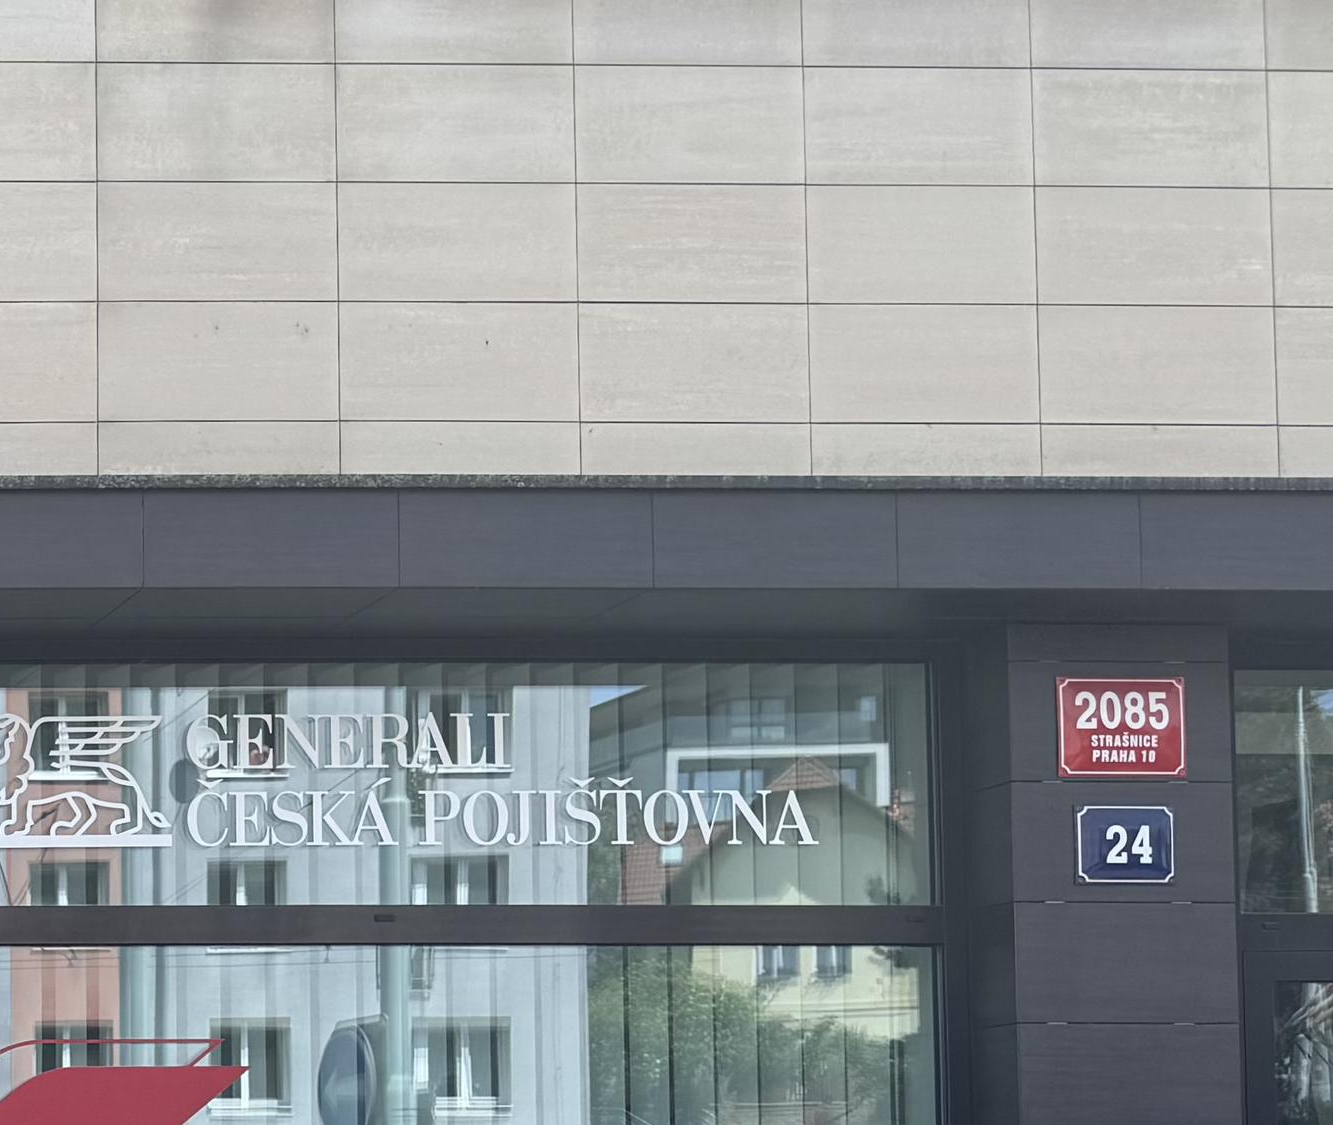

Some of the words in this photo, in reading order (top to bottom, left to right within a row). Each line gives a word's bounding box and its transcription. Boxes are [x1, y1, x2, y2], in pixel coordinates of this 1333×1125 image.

[1074, 691, 1170, 730] 2085
[186, 711, 512, 770] GENERALI
[1091, 732, 1159, 748] STRAŠNICE
[1092, 750, 1137, 763] PRAHA
[1141, 750, 1156, 763] 10
[186, 777, 399, 847] ČESKÁ
[418, 777, 820, 847] POJIŠŤOVNA
[1105, 825, 1153, 864] 24
